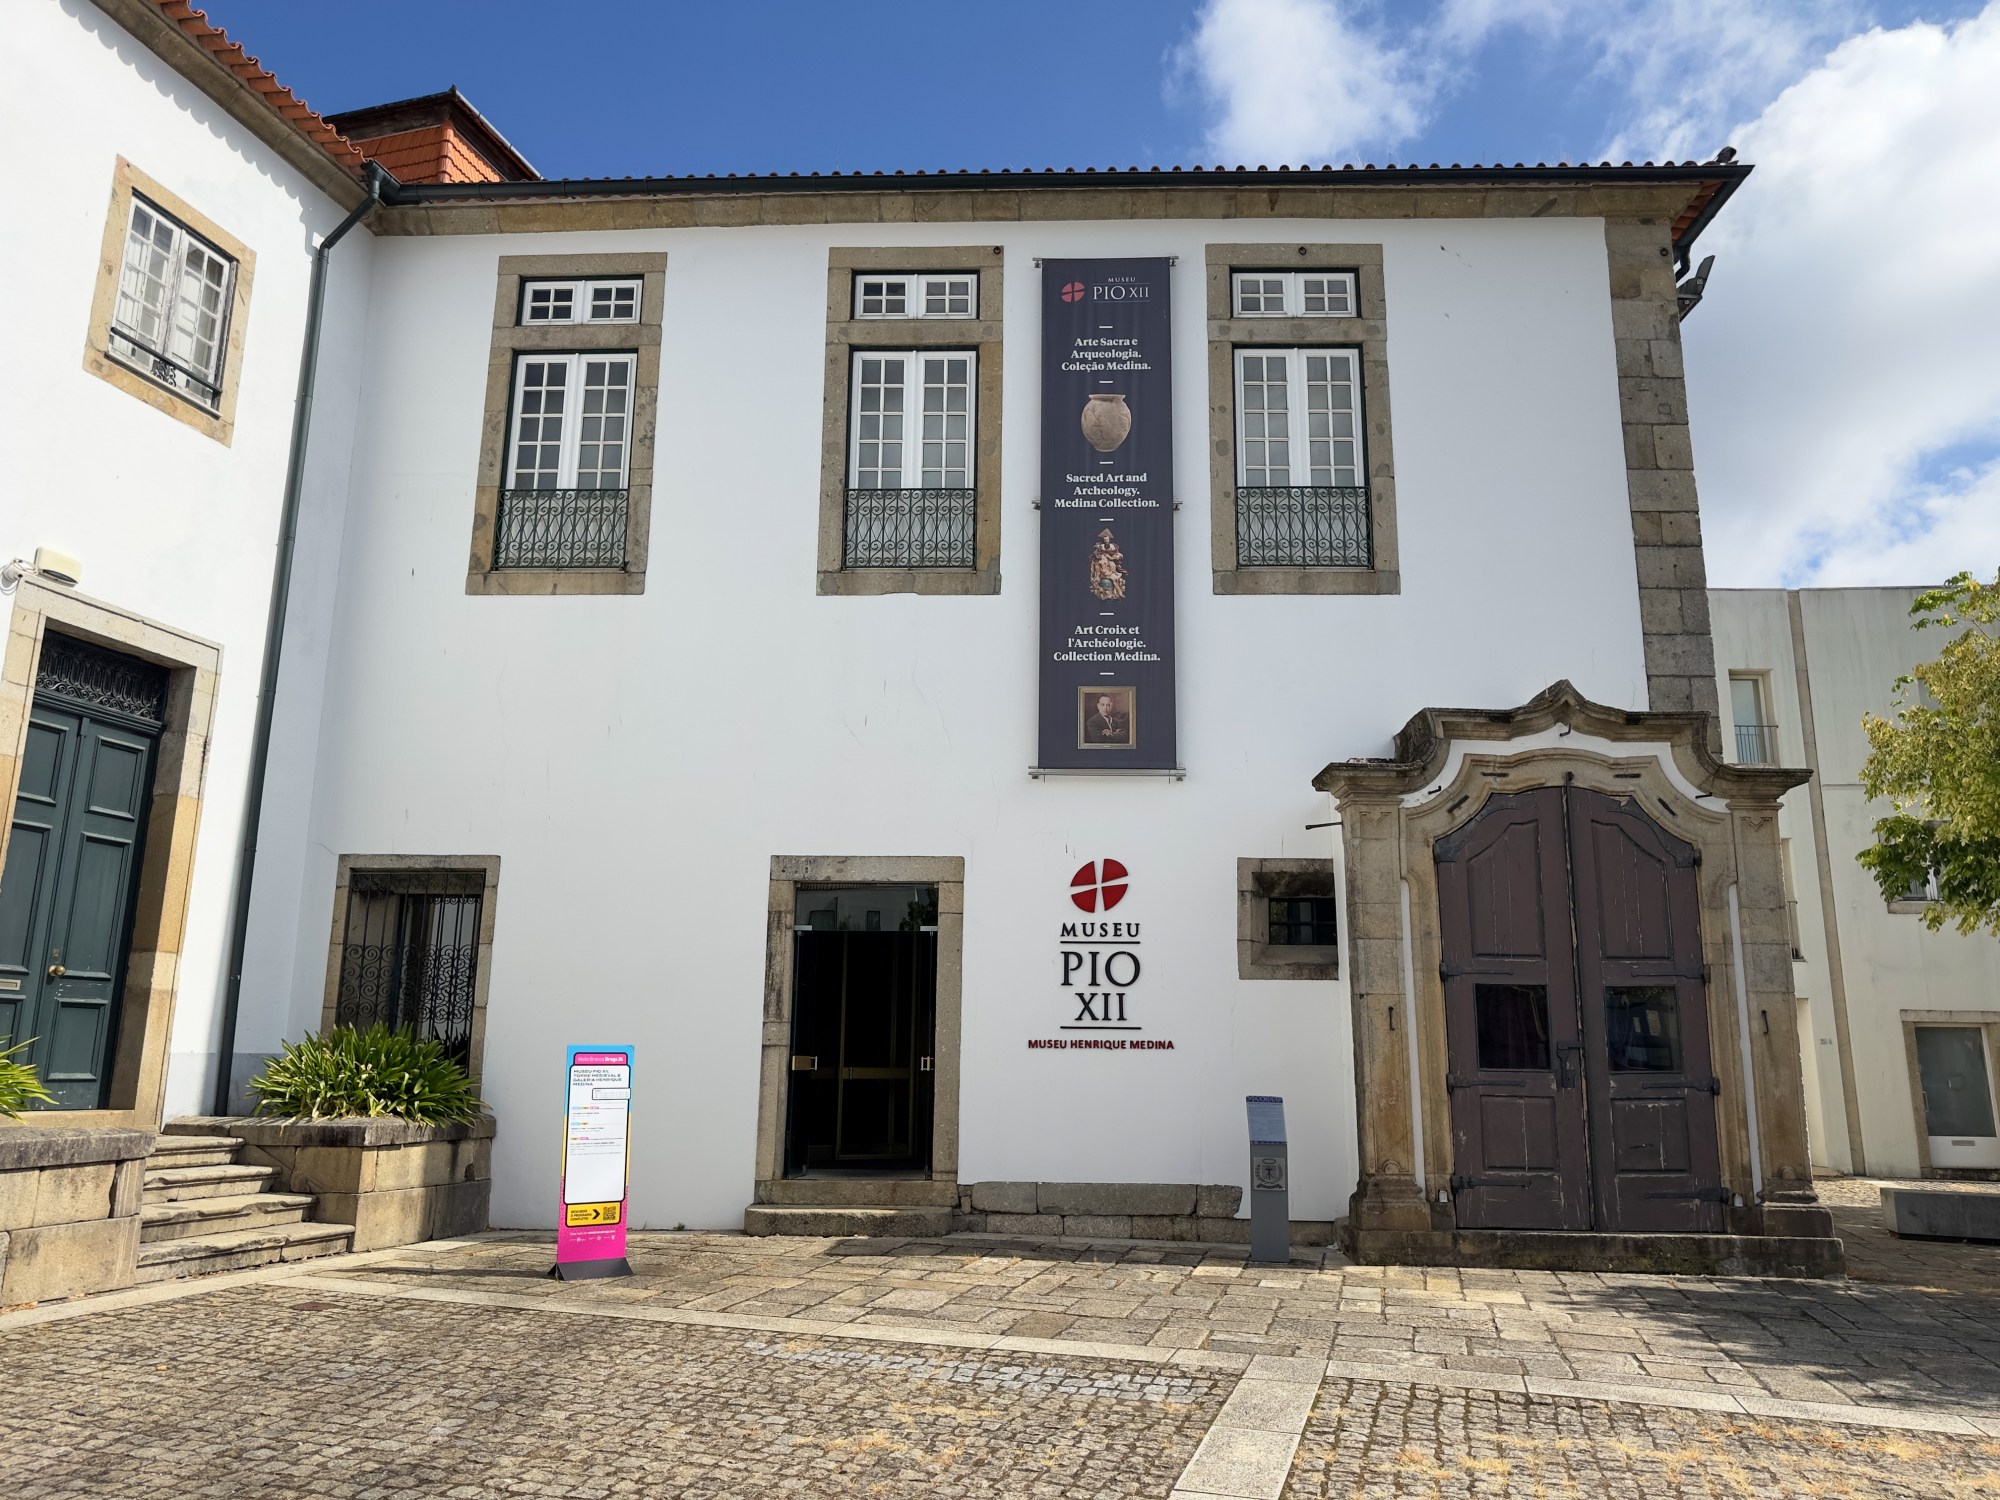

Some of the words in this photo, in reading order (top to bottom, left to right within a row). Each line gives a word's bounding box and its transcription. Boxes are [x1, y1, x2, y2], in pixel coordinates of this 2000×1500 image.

[1093, 285, 1126, 300] PIO
[1129, 286, 1149, 298] XII
[1075, 338, 1099, 346] Arte
[1100, 338, 1130, 346] Sacra
[1131, 338, 1138, 346] e
[1071, 349, 1141, 360] Arqueologia.
[1062, 361, 1105, 372] Coleção
[1106, 361, 1151, 370] Medina.
[1066, 473, 1104, 483] Sacred
[1105, 473, 1124, 483] Art
[1125, 472, 1148, 482] and
[1074, 486, 1139, 496] Archeology.
[1054, 498, 1097, 508] Medina
[1098, 498, 1160, 508] Collection.
[1074, 625, 1094, 635] Art
[1095, 625, 1128, 635] Croix
[1128, 625, 1140, 635] et
[1068, 638, 1146, 650] l'Archéologie.
[1053, 651, 1113, 662] Collection
[1114, 651, 1161, 662] Medina.
[1060, 922, 1140, 937] MUSEU
[1060, 951, 1141, 987] PIO
[1074, 992, 1127, 1021] XII
[1028, 1040, 1067, 1049] MUSEU
[1070, 1040, 1126, 1050] HENRIQUE
[1129, 1040, 1174, 1050] MEDINA
